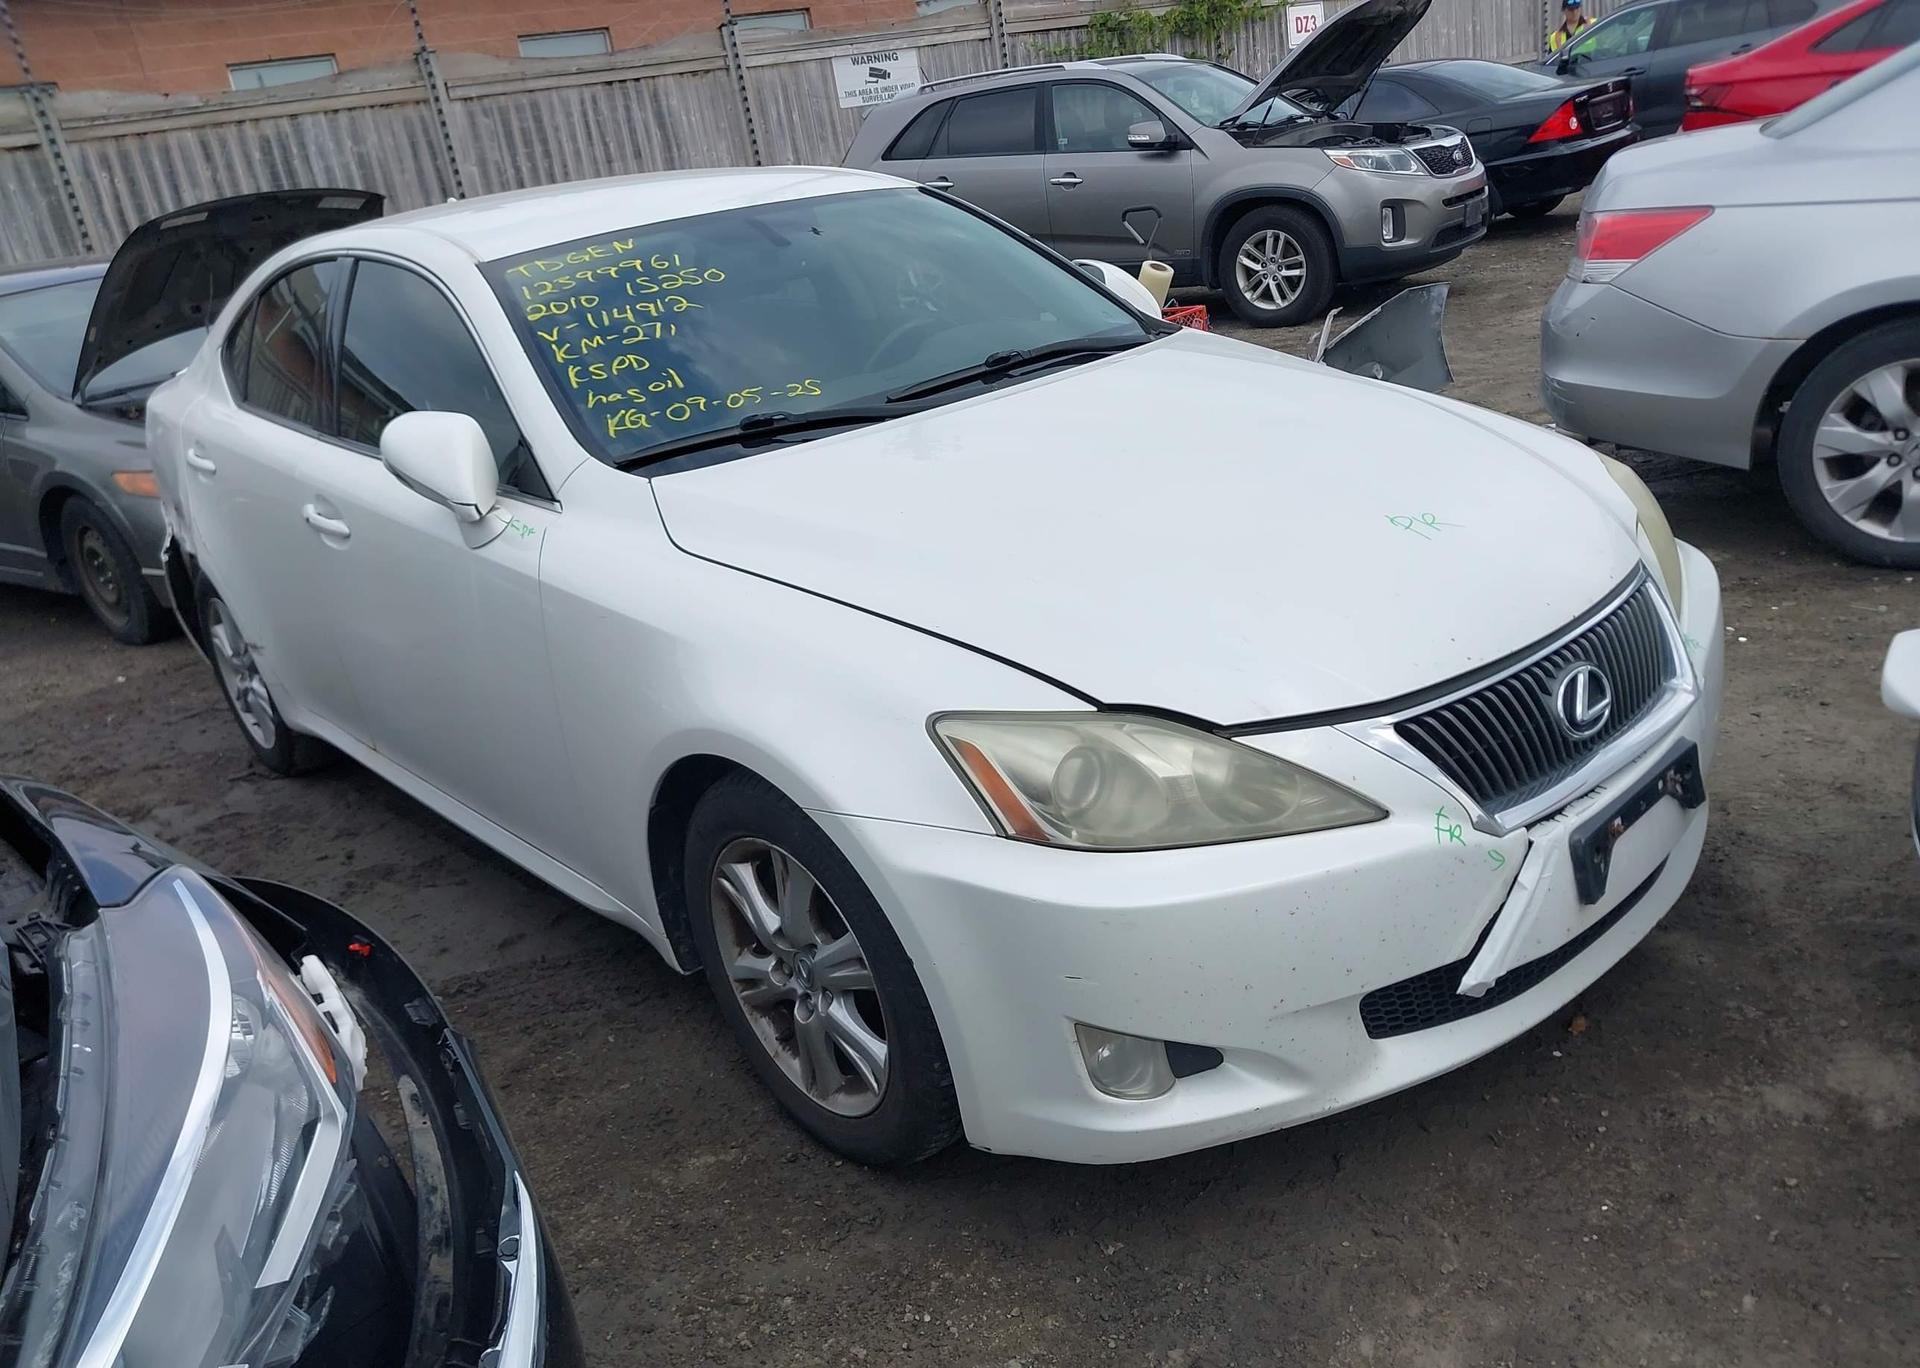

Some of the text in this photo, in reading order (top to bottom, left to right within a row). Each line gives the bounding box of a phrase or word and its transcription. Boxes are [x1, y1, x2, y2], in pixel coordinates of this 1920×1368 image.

[1295, 14, 1317, 34] DZ3
[850, 52, 899, 66] WARNING
[844, 90, 858, 99] THIS
[858, 87, 873, 96] AREA
[873, 86, 880, 95] IS
[880, 84, 898, 94] UNDER
[861, 92, 897, 103] SURVEILLAN
[526, 294, 600, 322] 2010
